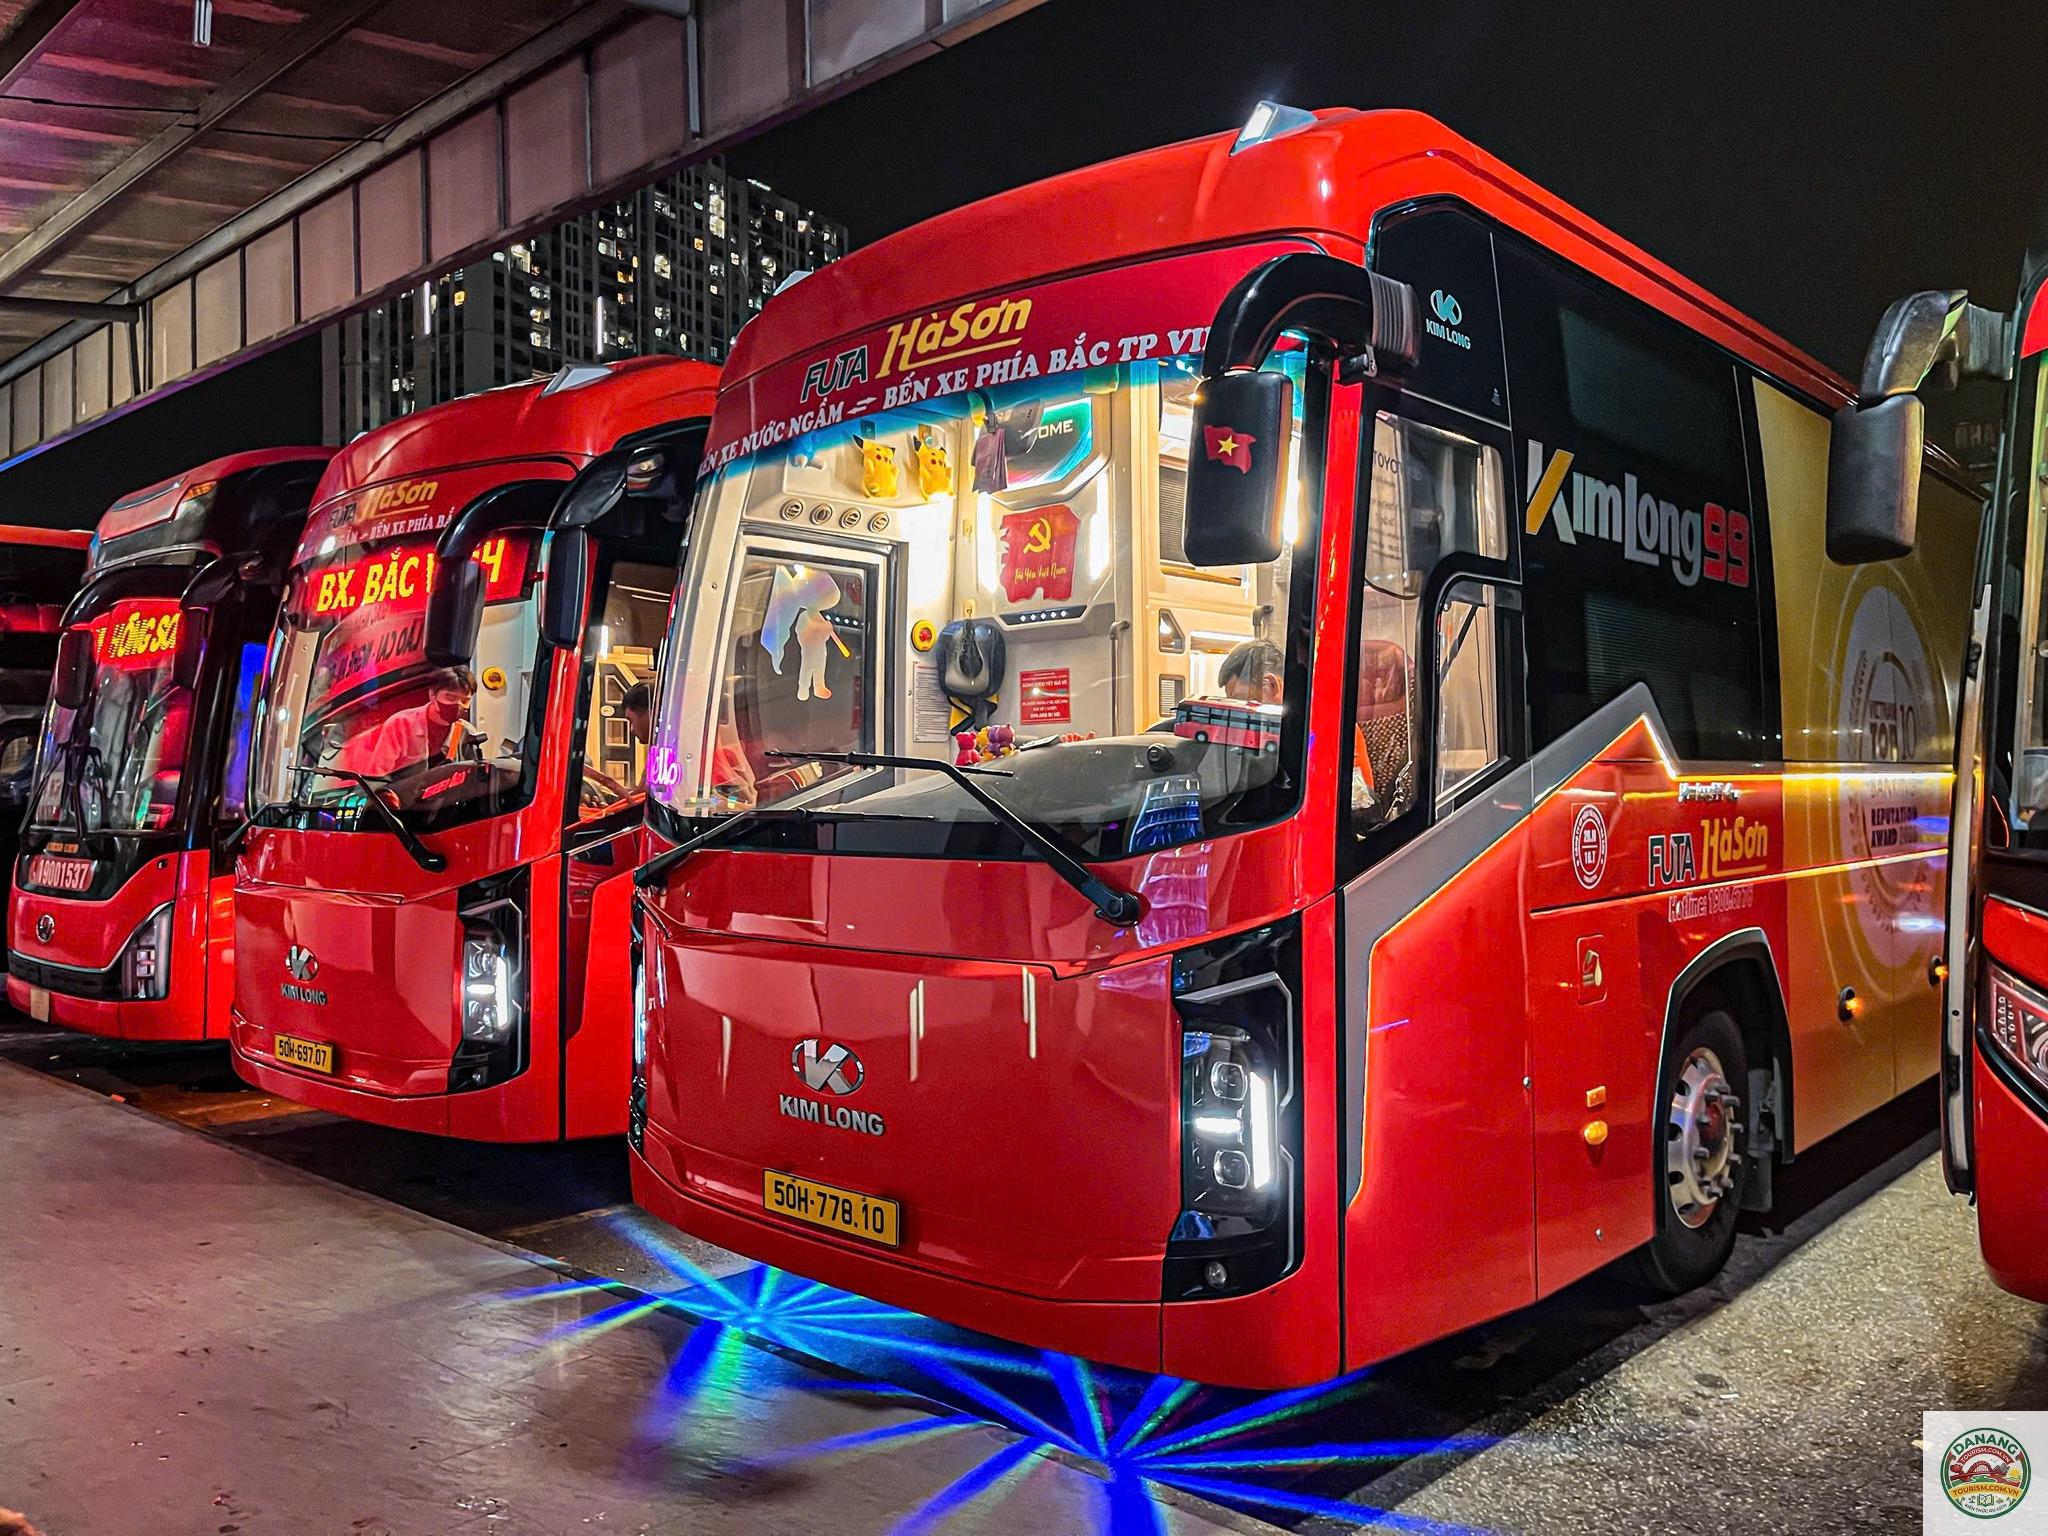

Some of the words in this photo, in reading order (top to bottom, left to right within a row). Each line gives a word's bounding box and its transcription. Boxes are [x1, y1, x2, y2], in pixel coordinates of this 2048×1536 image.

[800, 345, 869, 404] FUTA
[875, 298, 1033, 379] HàSơn
[1425, 318, 1446, 340] KIM
[1446, 327, 1472, 350] LONG
[719, 440, 739, 467] XE
[741, 421, 786, 454] NƯỚC
[788, 397, 845, 438] NGẦM
[882, 371, 931, 410] BẾN
[935, 368, 969, 397] XE
[974, 350, 1040, 388] PHÍA
[1047, 332, 1111, 374] BẮC
[1118, 333, 1158, 362] TP
[391, 520, 406, 536] XE
[406, 513, 434, 534] PHÍA
[436, 507, 455, 528] BẮ
[316, 569, 356, 612] BX.
[362, 547, 420, 606] BẮC
[1900, 705, 1918, 761] 10
[38, 859, 90, 889] 19001537
[1648, 833, 1696, 887] FUTA
[1700, 816, 1768, 880] HàSơn
[300, 987, 327, 1006] LONG
[278, 1039, 327, 1067] 50H-697.07
[779, 1094, 820, 1124] KIM
[823, 1104, 885, 1137] LONG
[773, 1179, 885, 1235] 50H-778.10
